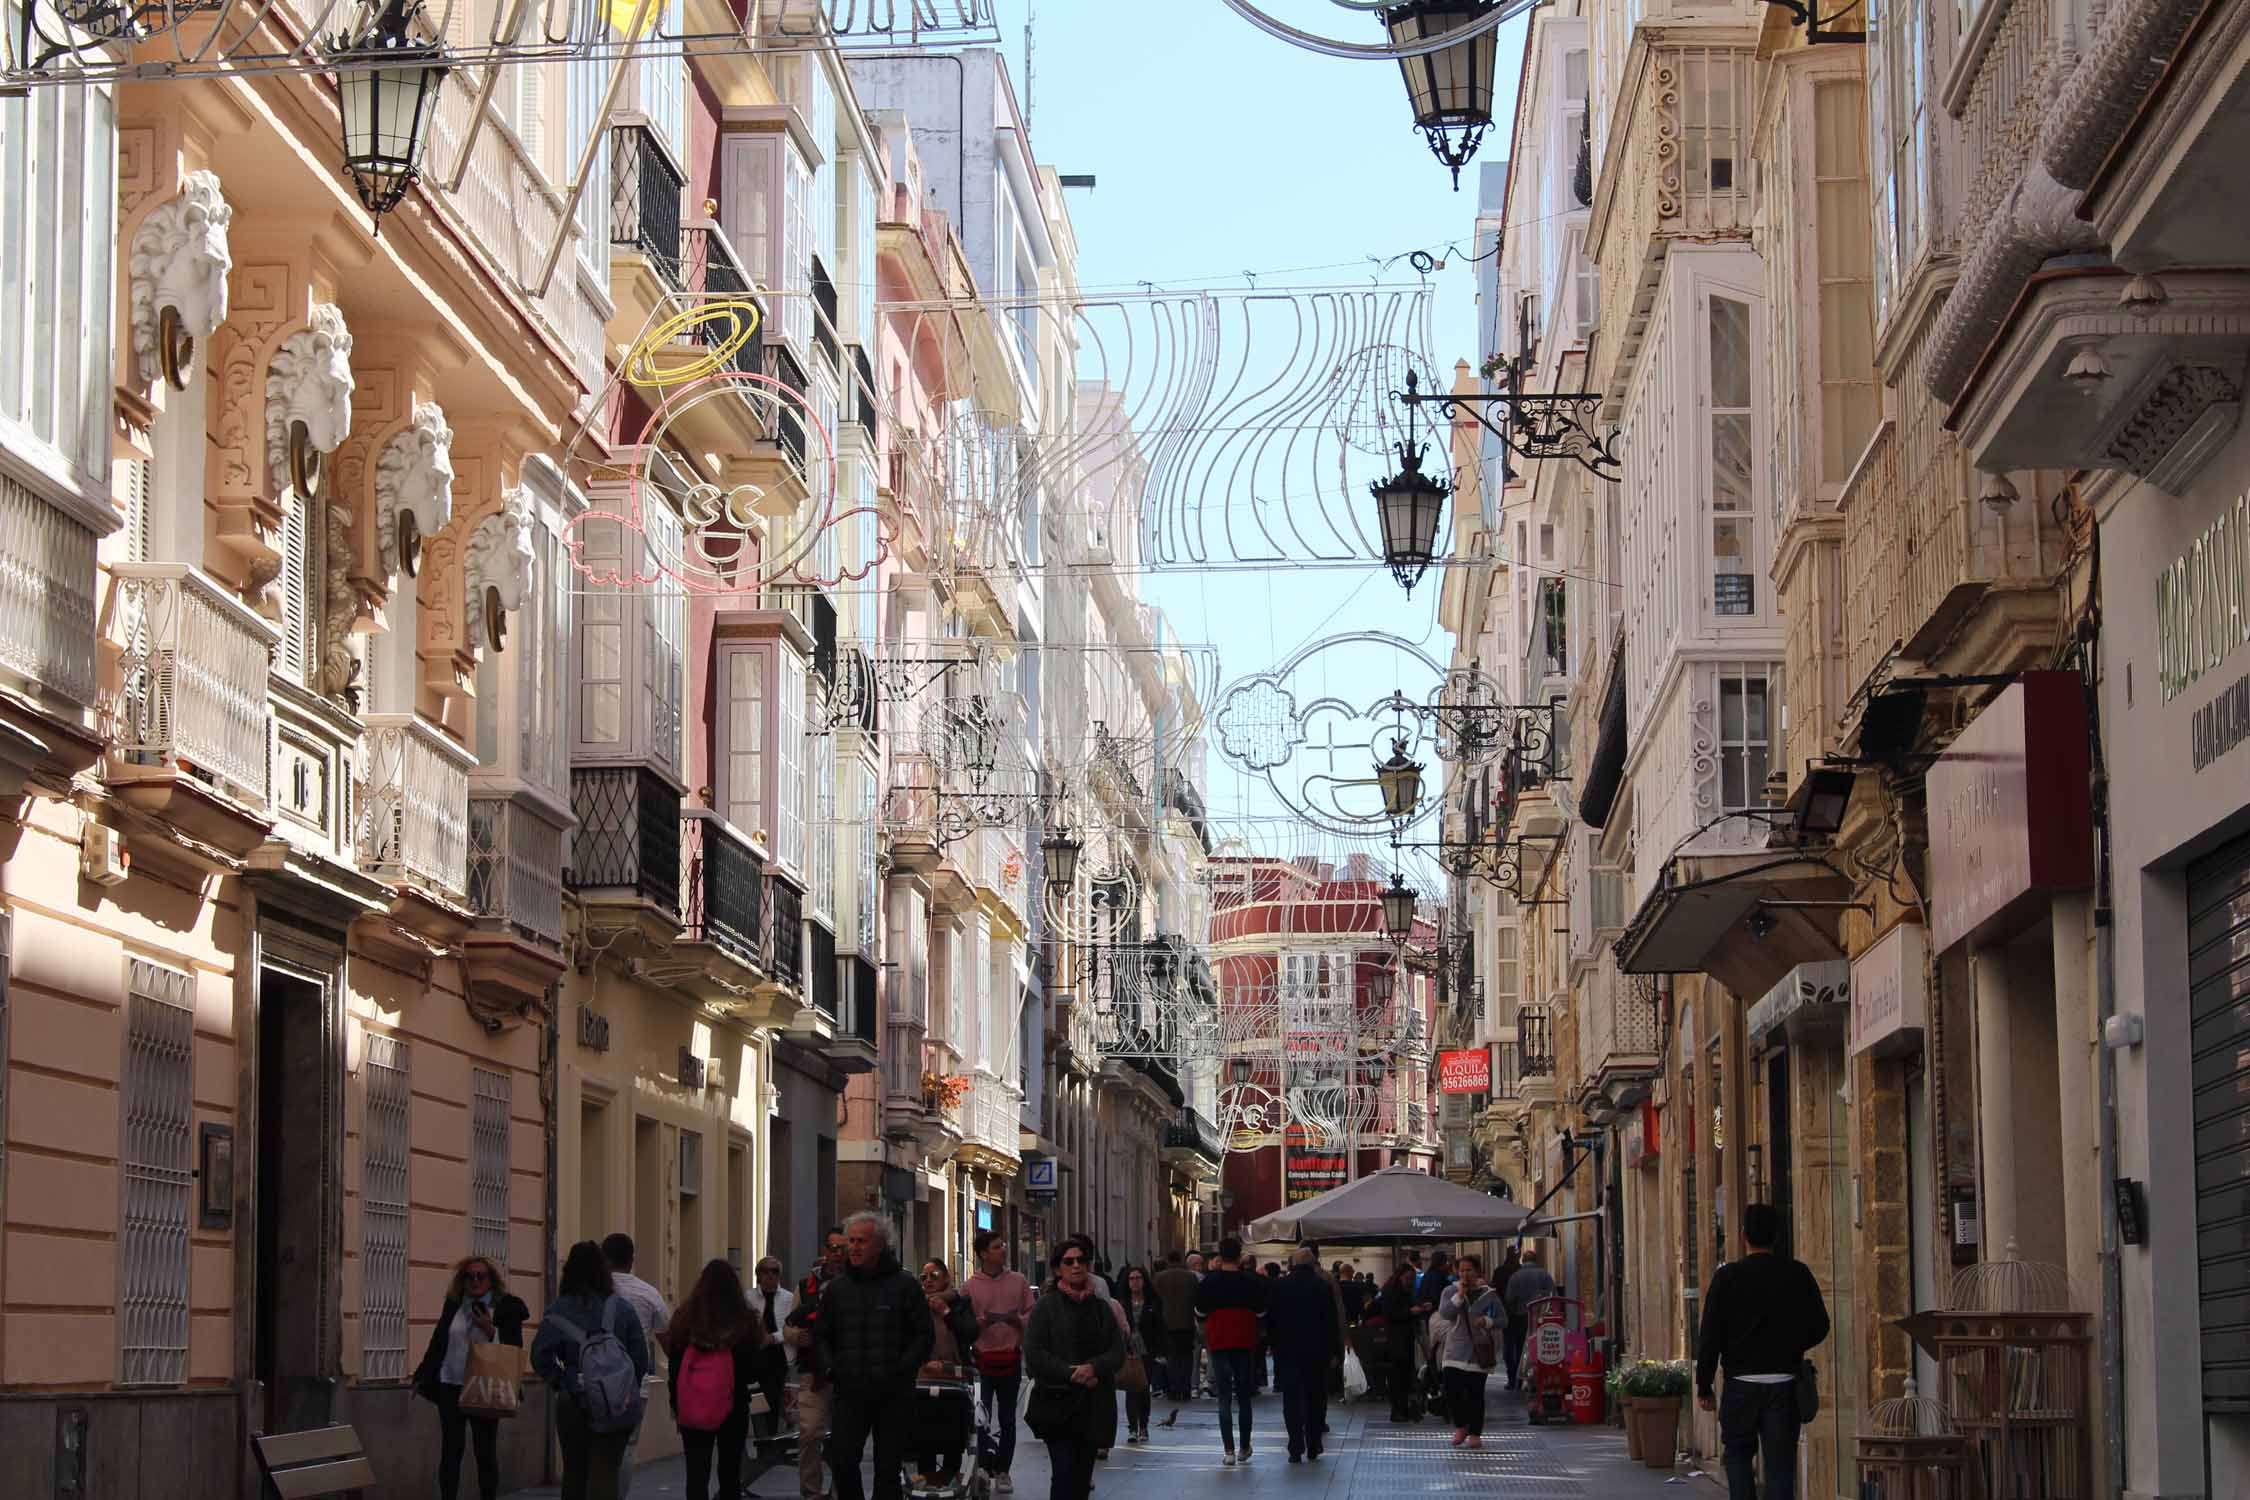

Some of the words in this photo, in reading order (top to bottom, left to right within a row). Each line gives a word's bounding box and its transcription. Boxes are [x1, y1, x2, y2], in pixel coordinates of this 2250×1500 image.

[2195, 487, 2250, 676] PISTAC
[1441, 1063, 1489, 1077] ALQUILA
[1442, 1074, 1489, 1089] 956266869
